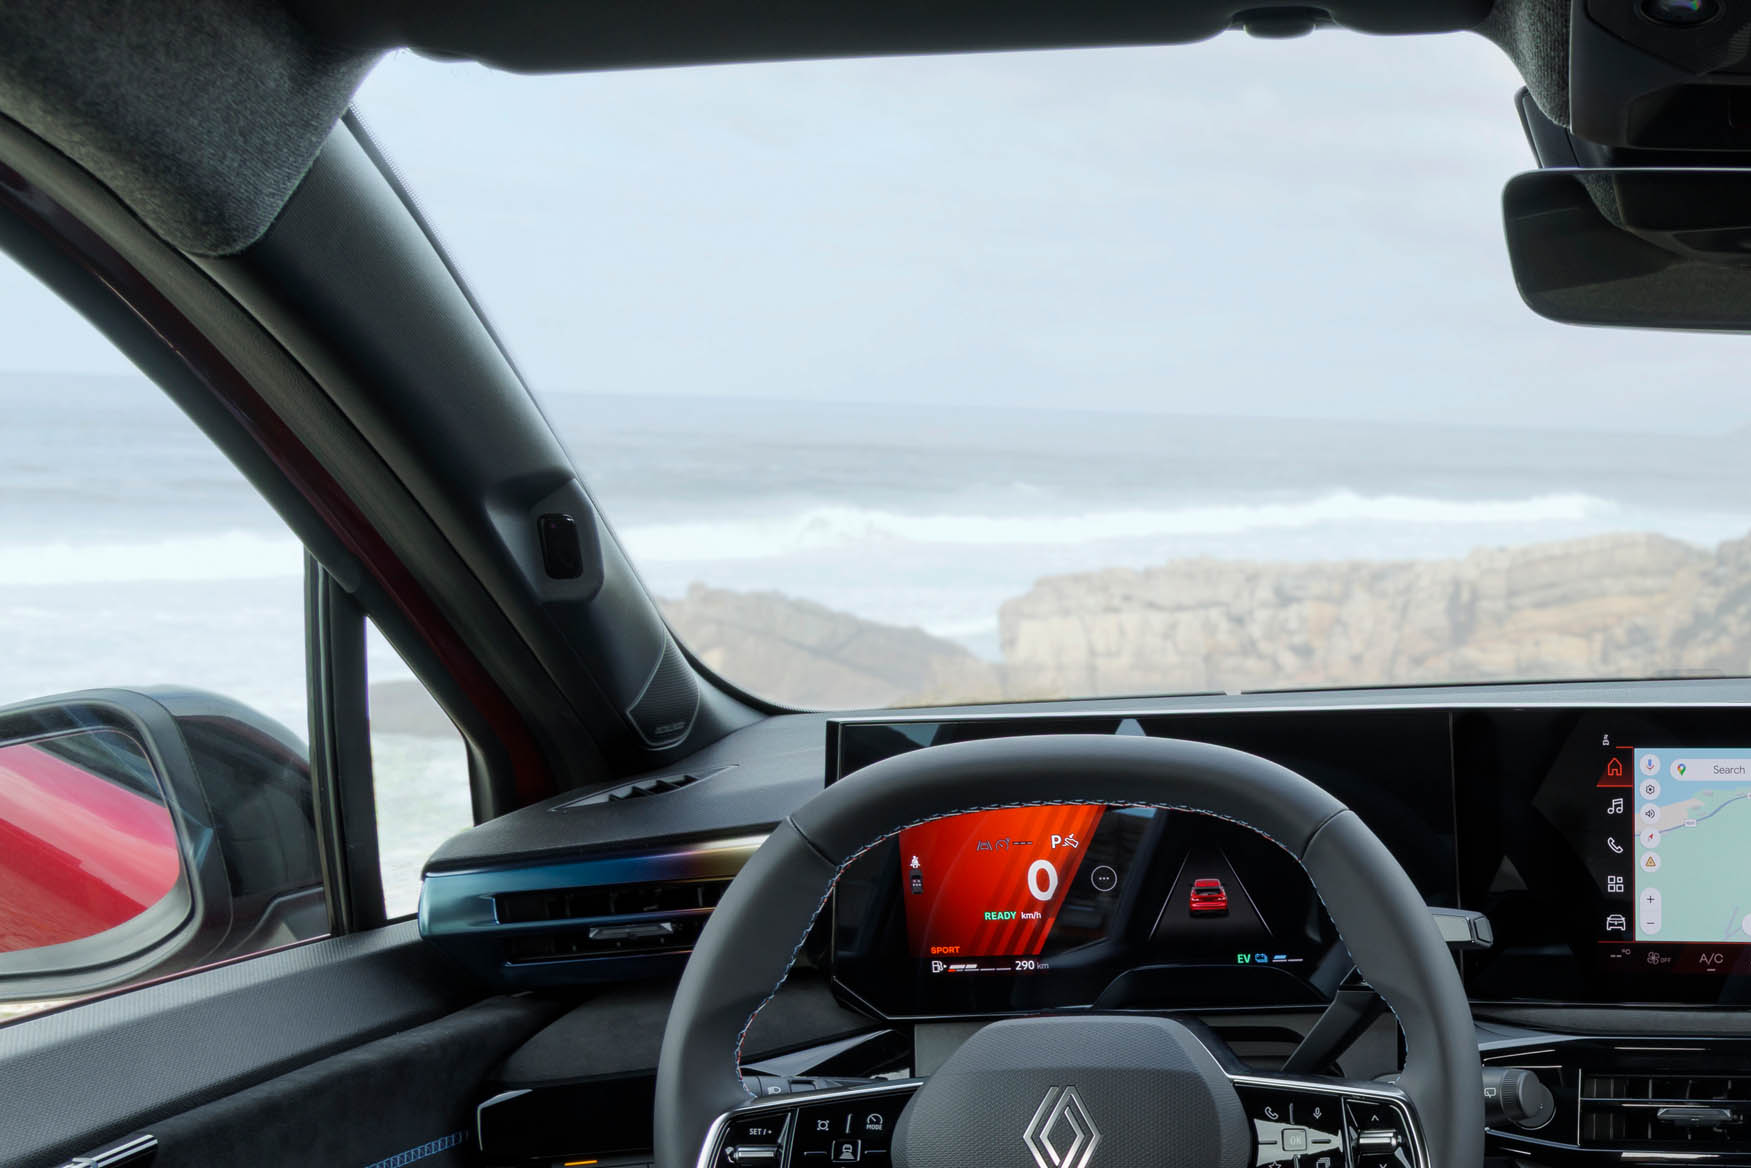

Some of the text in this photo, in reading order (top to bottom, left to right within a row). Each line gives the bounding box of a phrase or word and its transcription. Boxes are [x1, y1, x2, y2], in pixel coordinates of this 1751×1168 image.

[1713, 764, 1746, 776] Search
[1051, 834, 1062, 849] P
[1027, 859, 1059, 901] 0
[984, 911, 1042, 921] READY km/h
[930, 945, 961, 955] SPORT
[1237, 953, 1251, 964] EV
[1699, 952, 1724, 965] A/C
[1015, 960, 1049, 971] 290 km
[1290, 1135, 1302, 1145] OK
